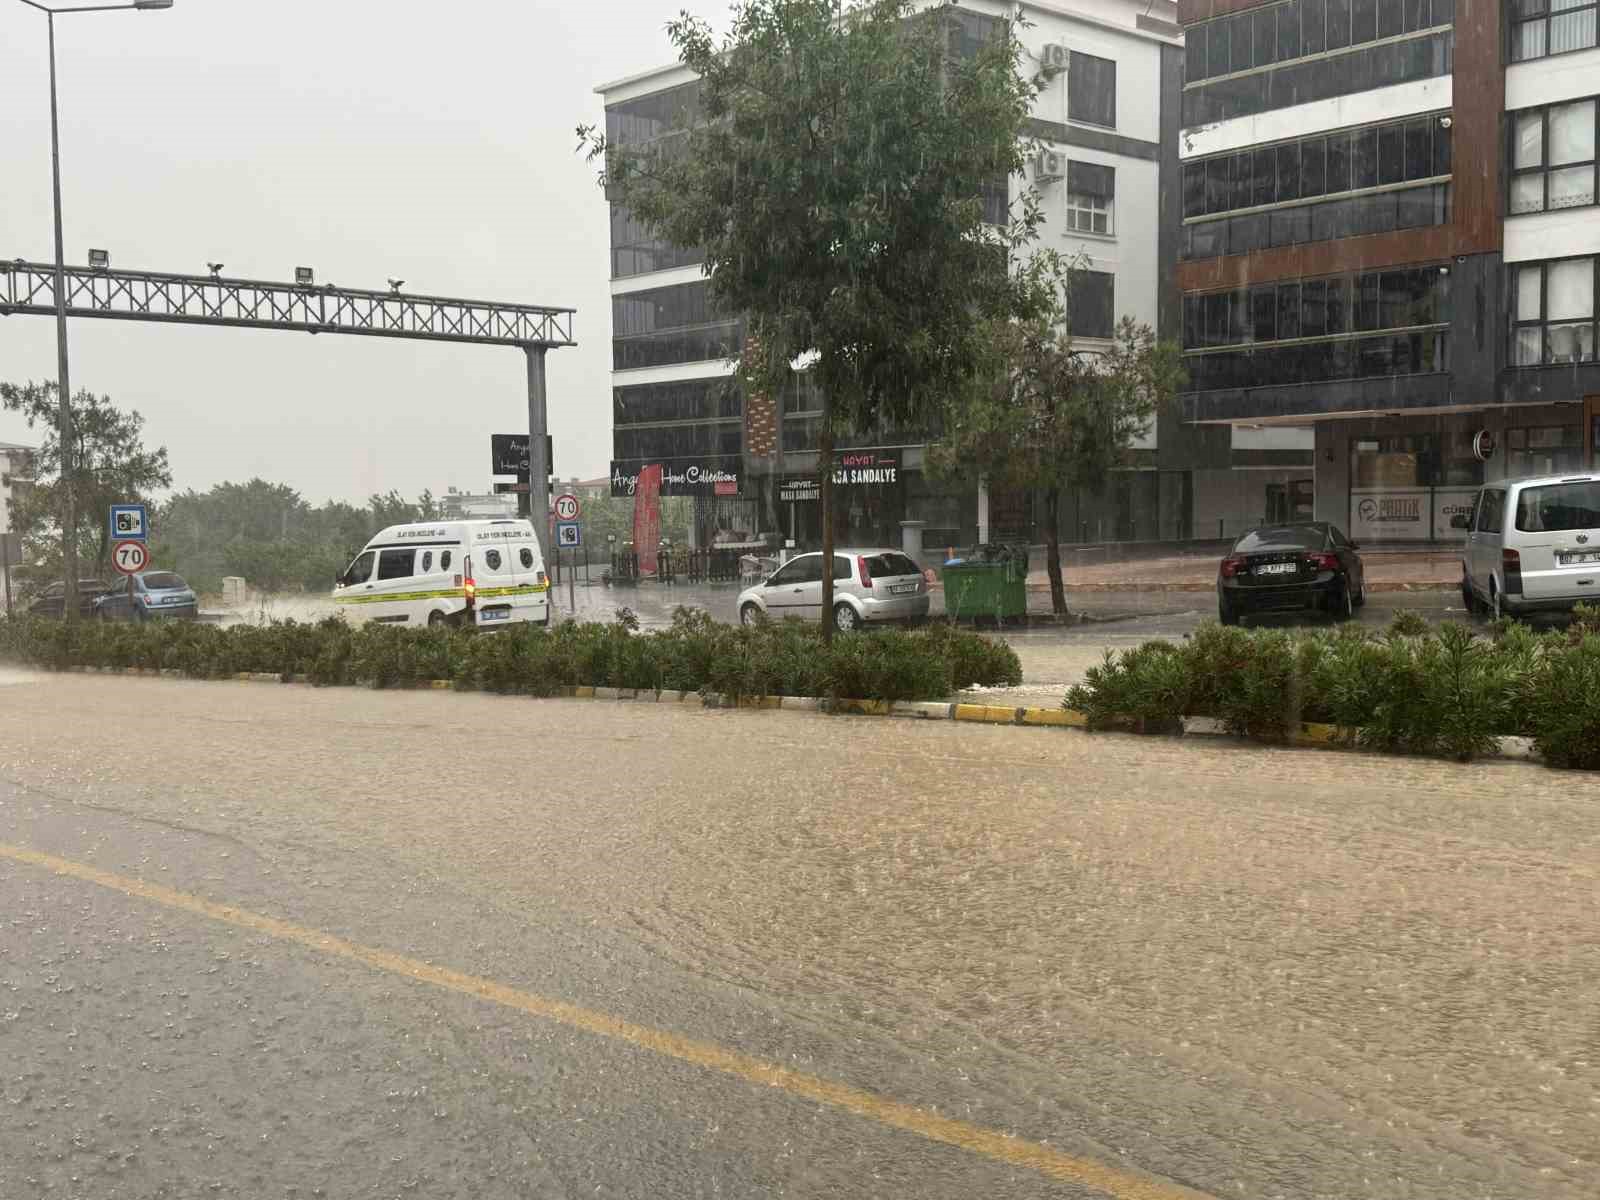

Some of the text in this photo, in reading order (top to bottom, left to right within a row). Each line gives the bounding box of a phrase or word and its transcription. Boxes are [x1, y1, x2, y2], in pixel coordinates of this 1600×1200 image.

[686, 465, 737, 484] Collections
[852, 468, 897, 484] SANDALYE
[560, 501, 575, 514] 70
[119, 549, 142, 565] 70
